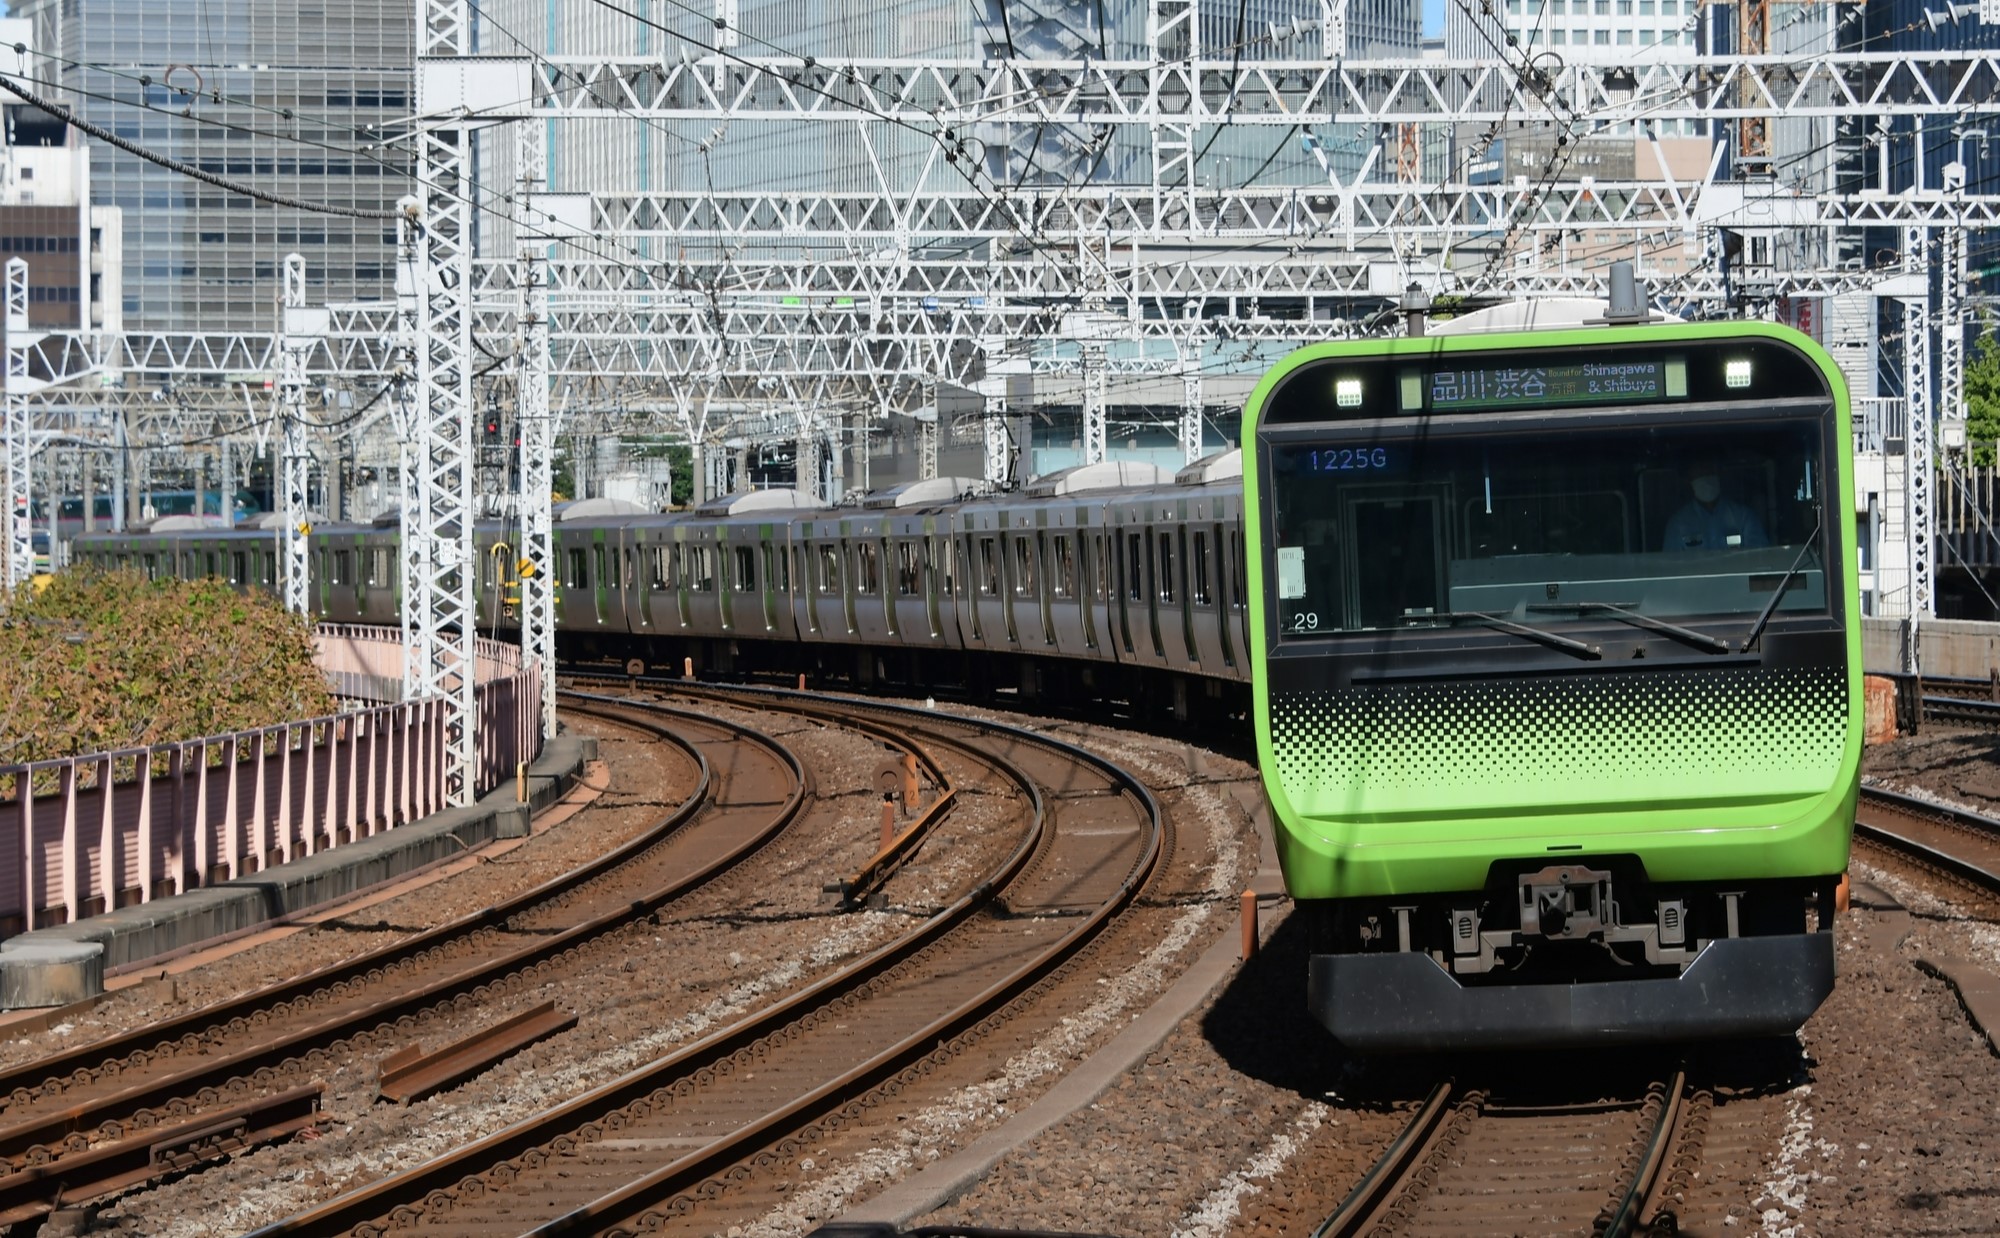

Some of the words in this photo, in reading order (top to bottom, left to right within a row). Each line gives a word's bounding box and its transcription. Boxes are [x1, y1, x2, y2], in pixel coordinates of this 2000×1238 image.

[1548, 369, 1570, 377] Bound
[1570, 368, 1582, 377] for
[1583, 362, 1655, 378] Shinagawa
[1432, 368, 1547, 401] 品川・渋谷
[1549, 381, 1576, 396] 方面
[1588, 380, 1601, 393] &
[1604, 379, 1656, 394] Shibuya
[1310, 447, 1387, 471] 1225G
[1294, 612, 1318, 630] 29
[909, 791, 915, 801] 2
